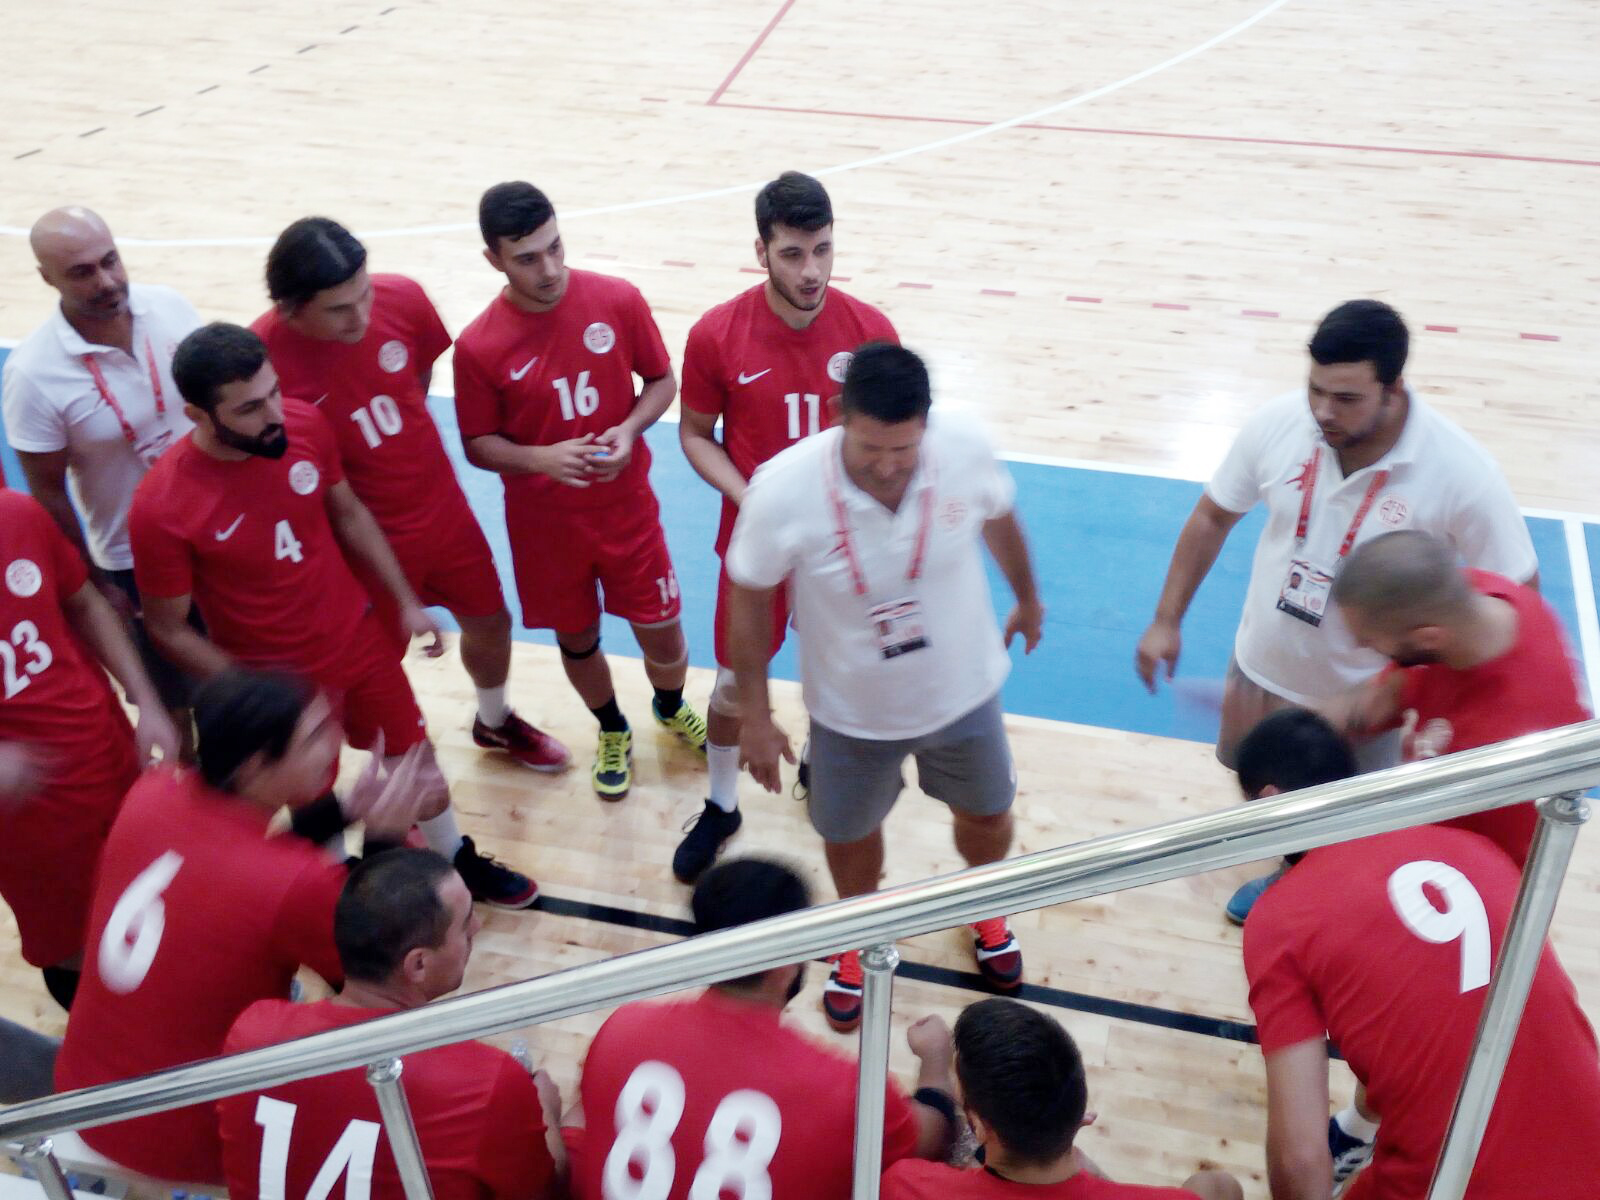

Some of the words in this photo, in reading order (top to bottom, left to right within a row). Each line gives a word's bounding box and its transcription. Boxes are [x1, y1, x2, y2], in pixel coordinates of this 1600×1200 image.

[351, 395, 403, 449] 10
[551, 370, 600, 420] 16
[784, 393, 820, 439] 11
[274, 520, 303, 563] 4
[656, 570, 679, 604] 16
[0, 619, 53, 699] 23
[98, 849, 185, 994] 6
[1387, 859, 1491, 993] 9
[254, 1095, 381, 1200] 14
[602, 1060, 783, 1200] 88
